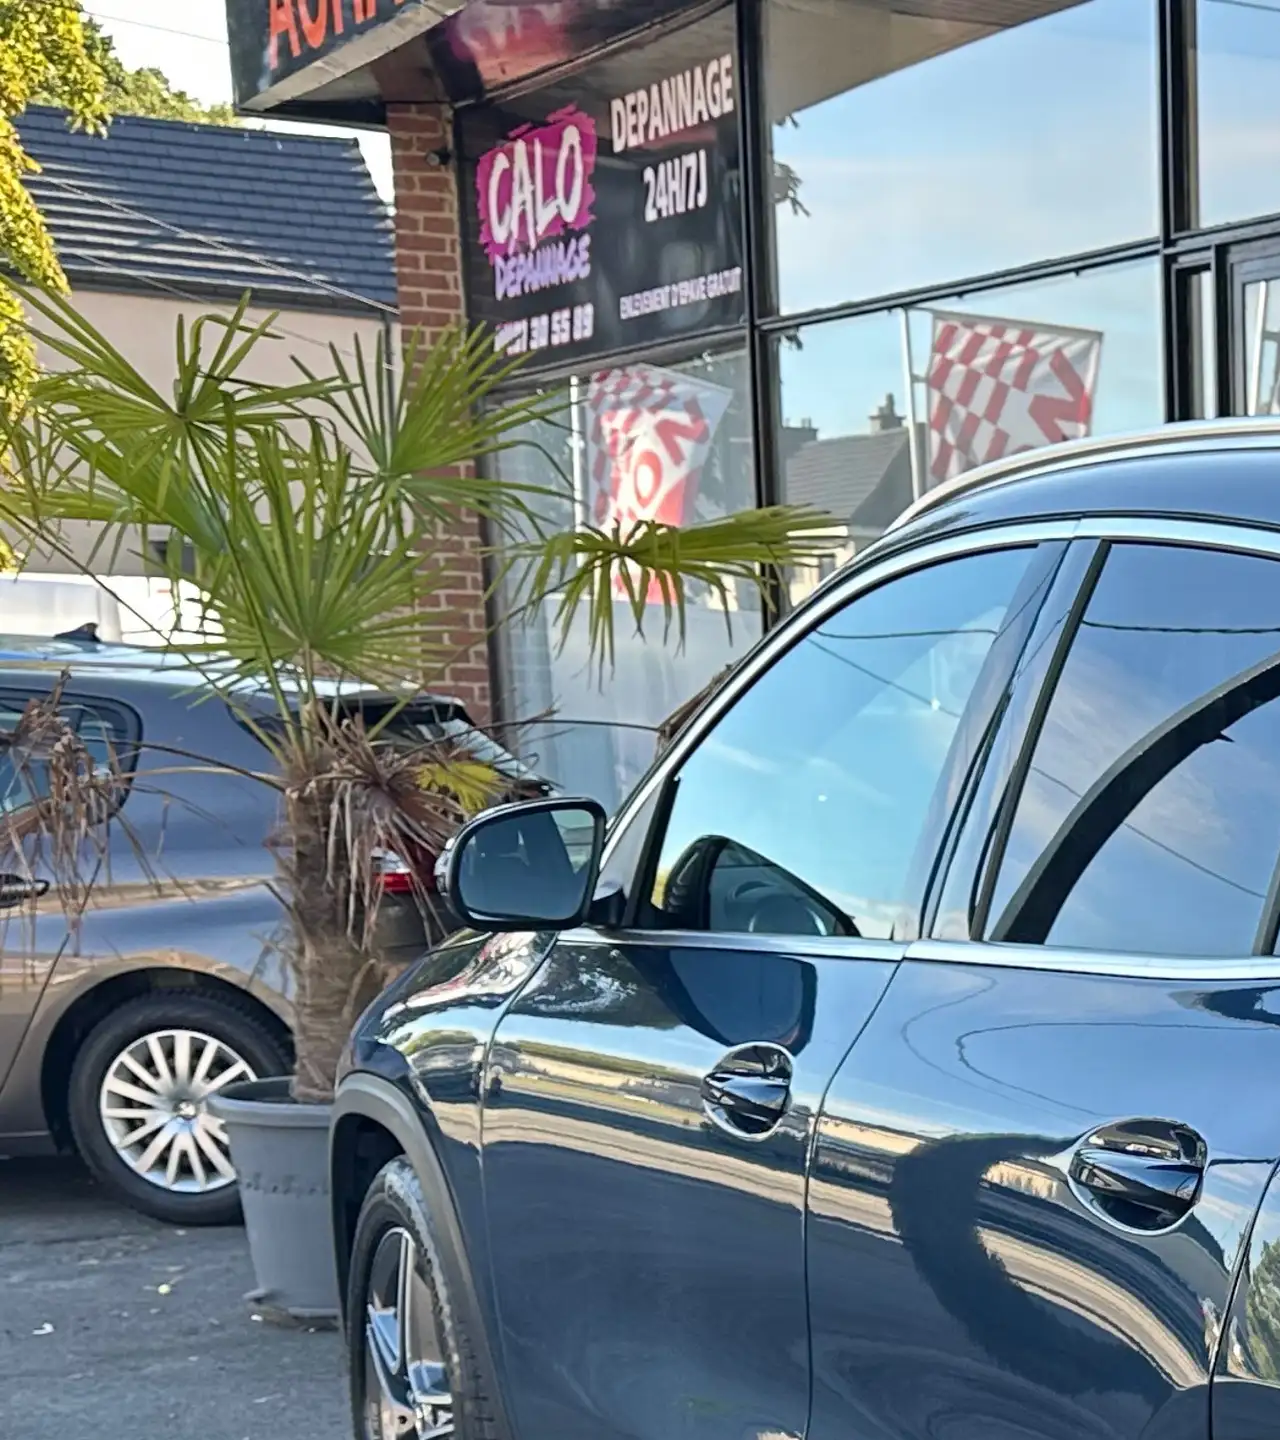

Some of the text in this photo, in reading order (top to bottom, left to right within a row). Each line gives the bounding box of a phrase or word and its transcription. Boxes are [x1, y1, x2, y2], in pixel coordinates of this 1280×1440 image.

[611, 54, 734, 153] DEPANNAGE
[488, 125, 584, 250] CALO
[643, 149, 708, 222] 24H/7J
[495, 233, 591, 301] DEPANNAGE
